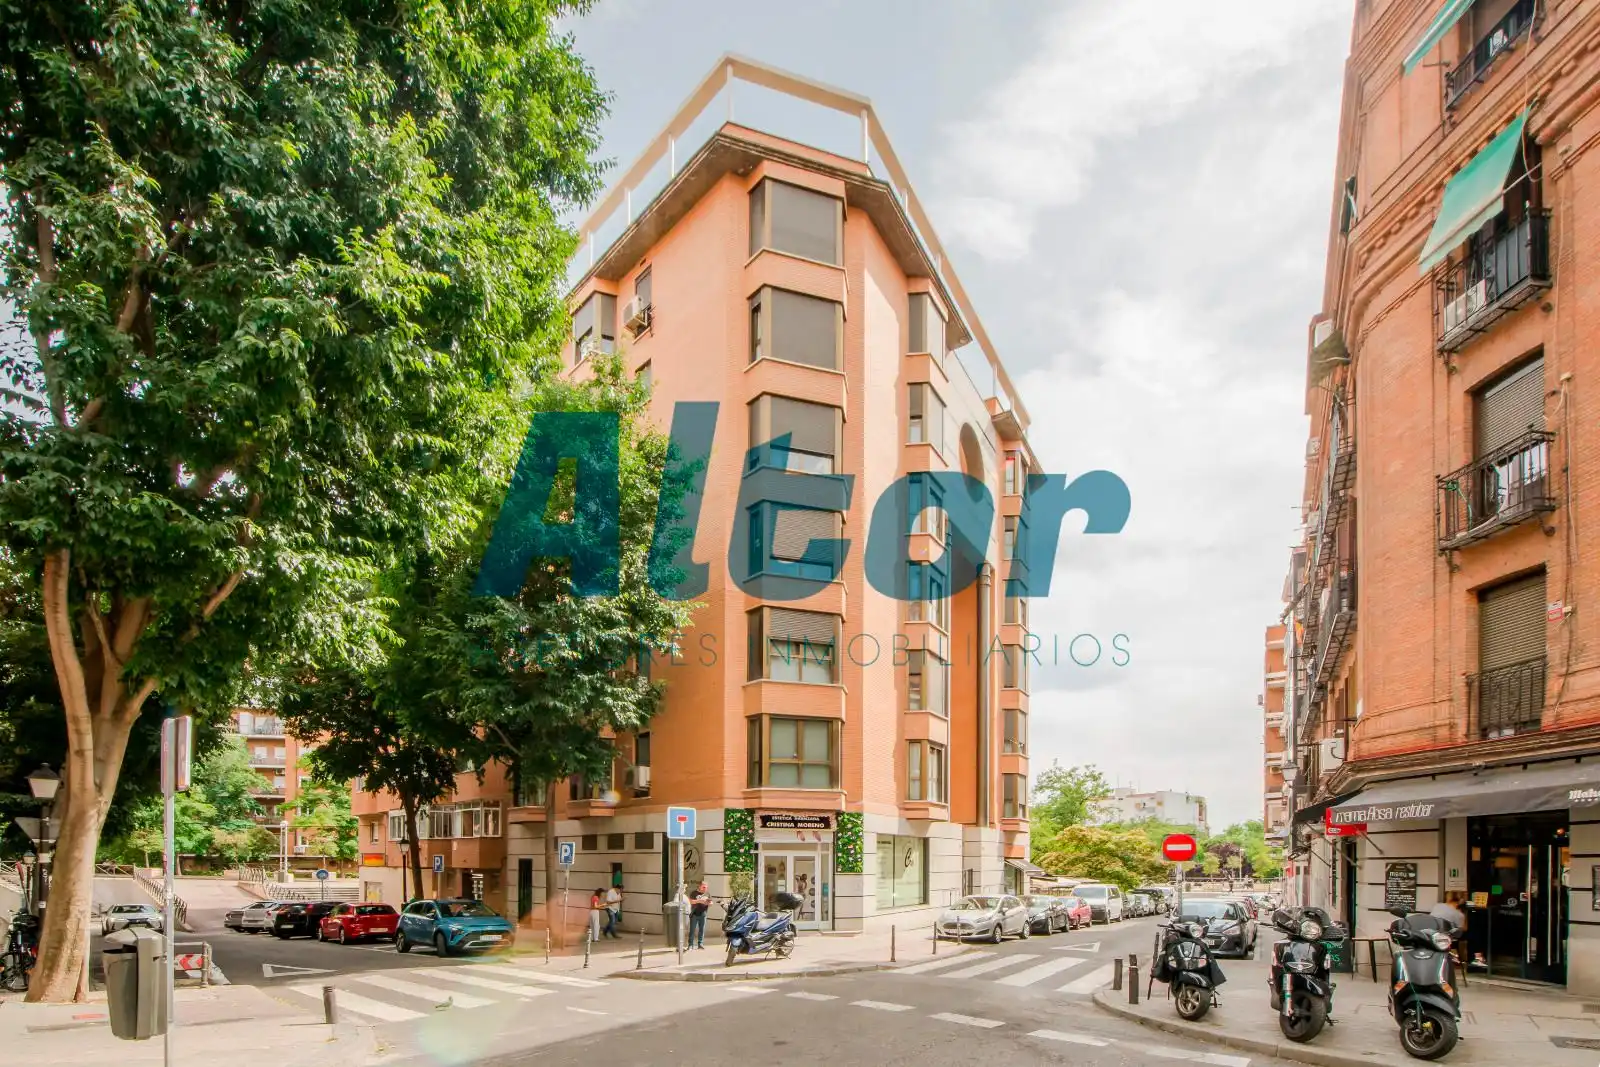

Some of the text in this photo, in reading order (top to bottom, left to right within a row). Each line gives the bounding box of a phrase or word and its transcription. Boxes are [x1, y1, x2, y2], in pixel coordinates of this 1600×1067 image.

[1395, 802, 1435, 819] restobar
[562, 845, 571, 862] P
[435, 857, 441, 871] P
